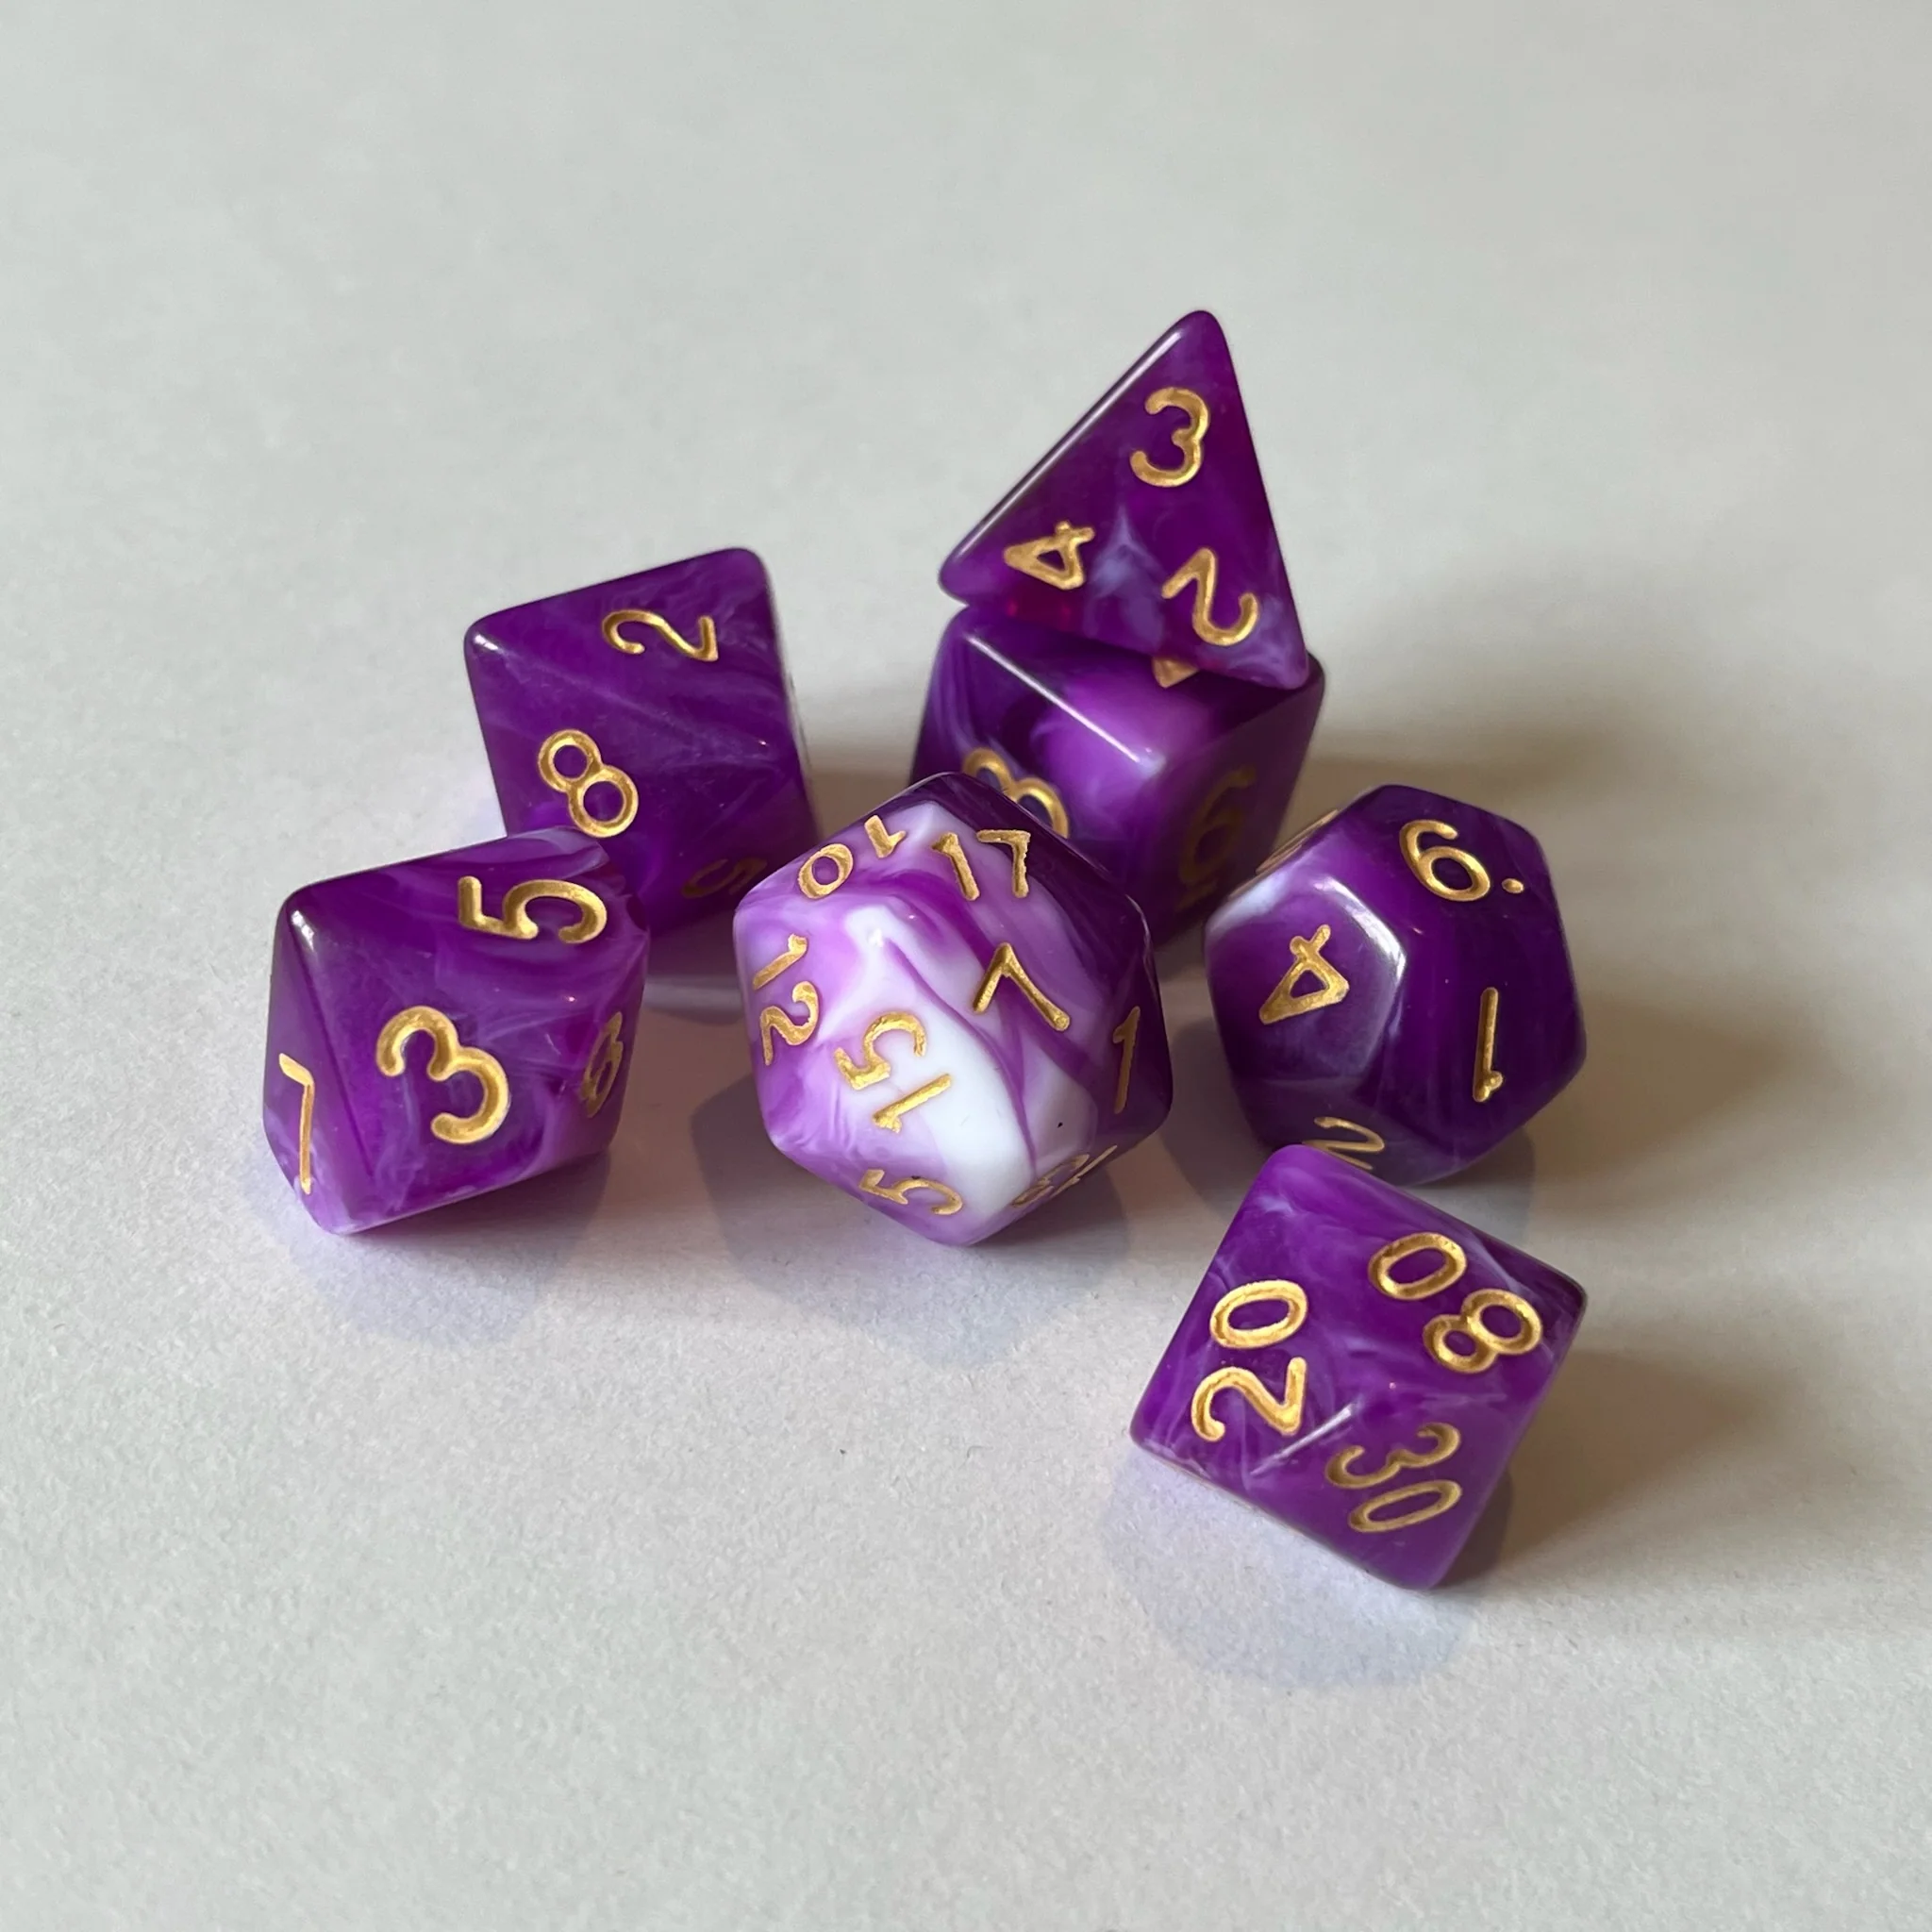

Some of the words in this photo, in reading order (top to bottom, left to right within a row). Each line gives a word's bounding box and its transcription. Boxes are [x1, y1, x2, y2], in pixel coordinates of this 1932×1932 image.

[1130, 386, 1210, 488] 3
[1004, 520, 1094, 591] 4
[1161, 547, 1259, 646] 2
[602, 608, 719, 662] 2
[538, 728, 640, 839] 8
[458, 875, 608, 944] 5
[798, 815, 906, 900] 10
[929, 829, 1031, 901] 17
[753, 933, 819, 1066] 12
[973, 942, 1072, 1031] 7
[1258, 924, 1350, 1025] 4
[375, 1005, 510, 1144] 3
[833, 1011, 953, 1134] 15
[1113, 1006, 1141, 1114] 1
[1473, 987, 1504, 1102] 1
[279, 1053, 315, 1194] 7
[858, 1168, 964, 1216] 5
[1368, 1232, 1542, 1374] 80
[1191, 1279, 1307, 1443] 20
[1325, 1423, 1462, 1533] 30
